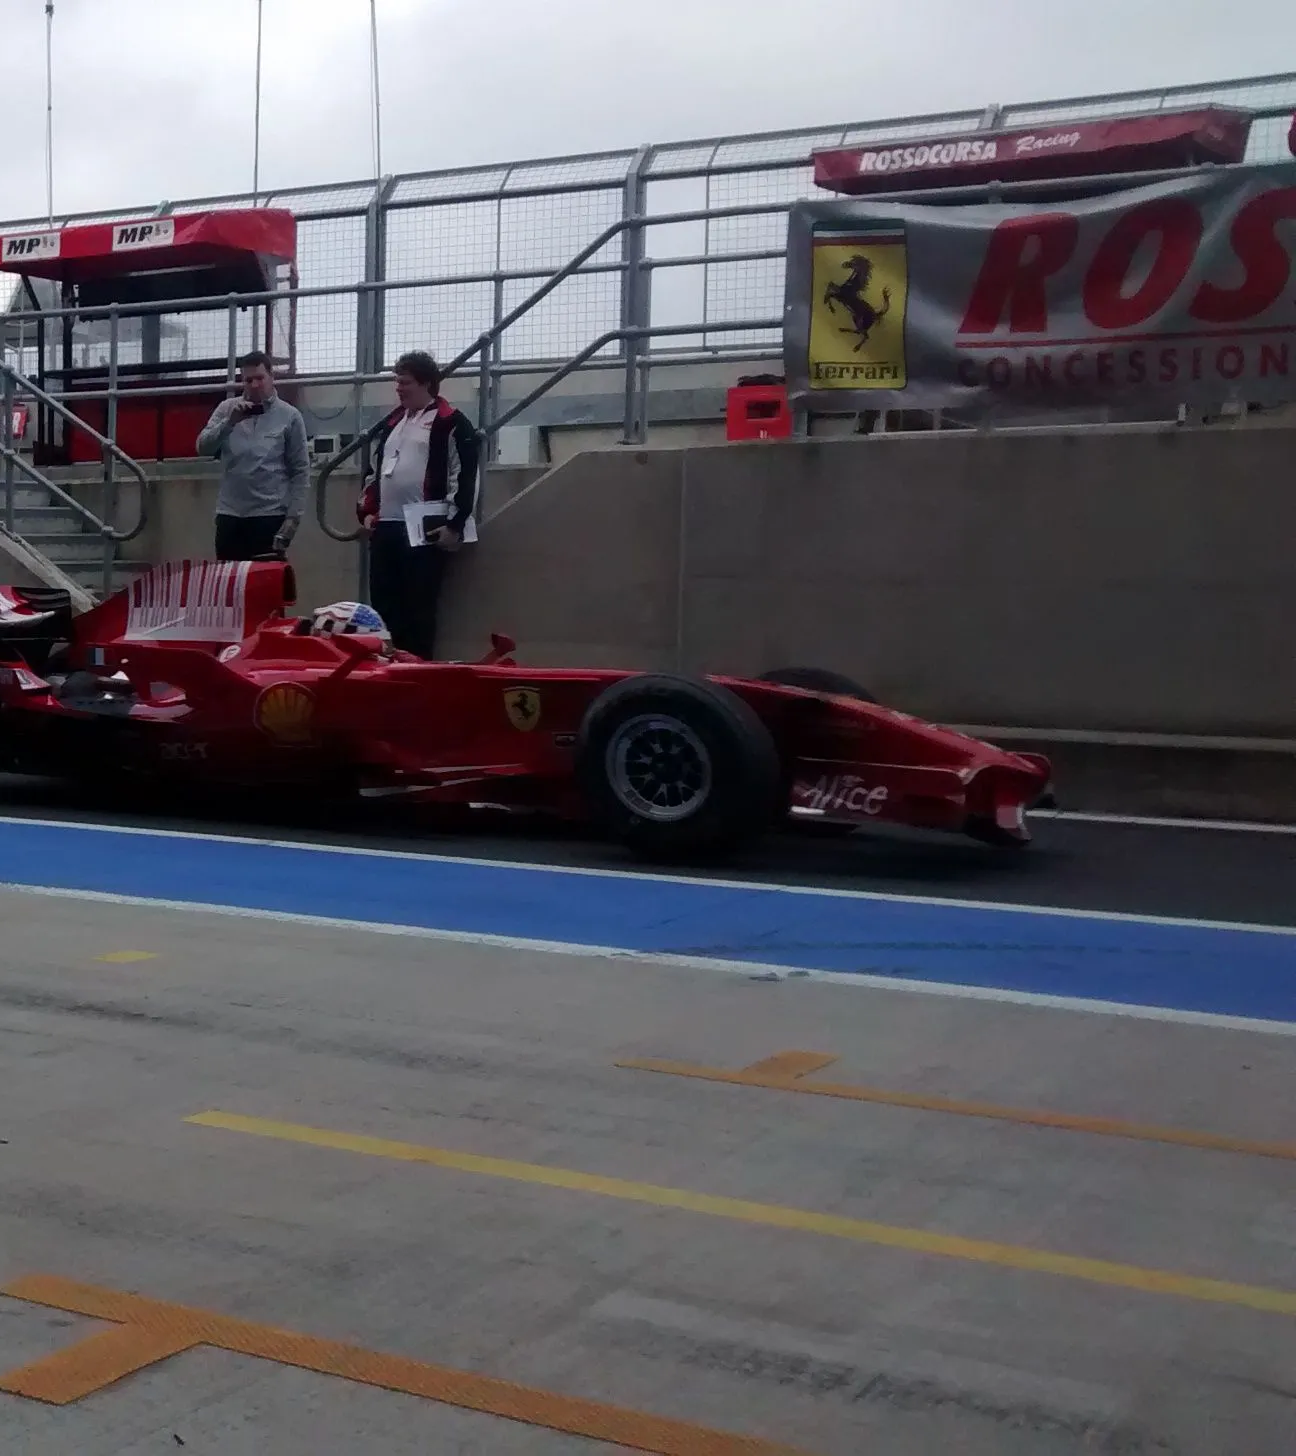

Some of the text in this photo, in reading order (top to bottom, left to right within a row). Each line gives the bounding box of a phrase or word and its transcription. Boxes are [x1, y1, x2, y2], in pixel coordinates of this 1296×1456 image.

[859, 130, 1081, 172] ROSSOCORSA Racing
[6, 237, 41, 256] MP
[116, 225, 153, 245] MP
[957, 187, 1296, 334] ROS
[956, 344, 1289, 388] CONCESSION
